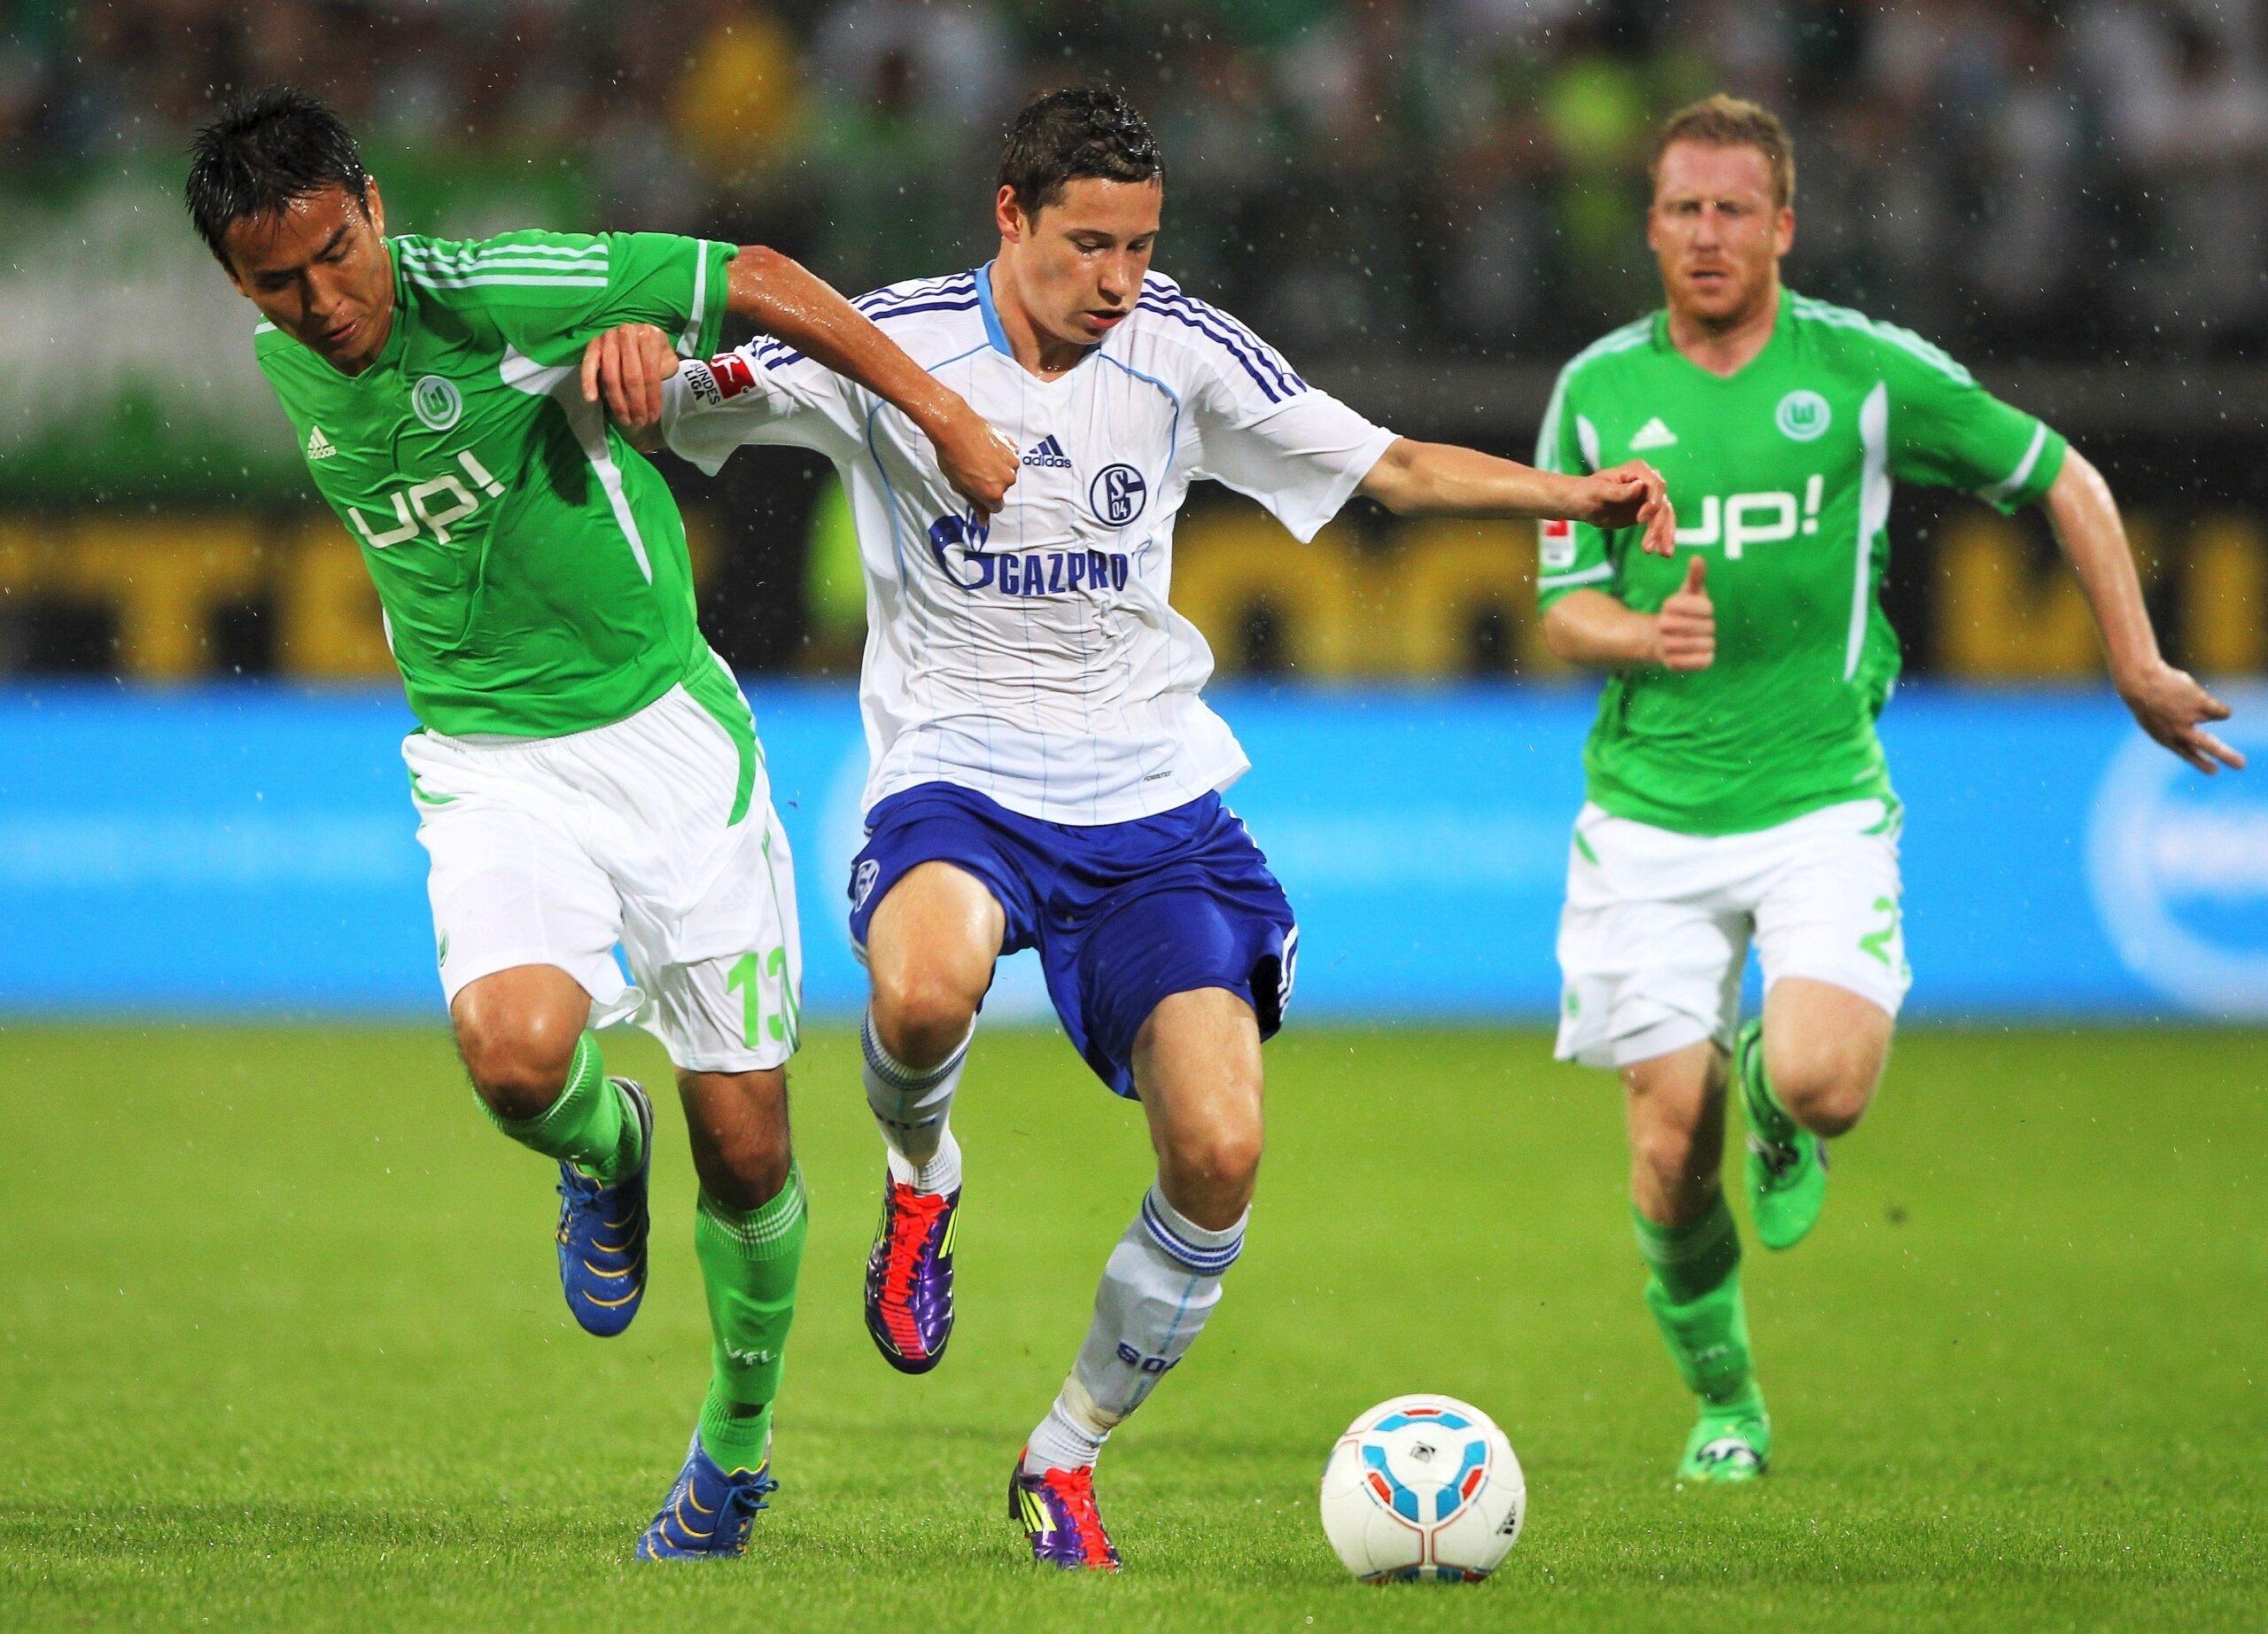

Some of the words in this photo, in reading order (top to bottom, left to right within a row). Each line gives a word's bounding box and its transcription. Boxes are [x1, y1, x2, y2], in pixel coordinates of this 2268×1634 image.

[684, 370, 705, 401] LIGA
[307, 446, 337, 459] adidas
[1022, 455, 1071, 468] adidas
[999, 549, 1135, 595] GAZPRO
